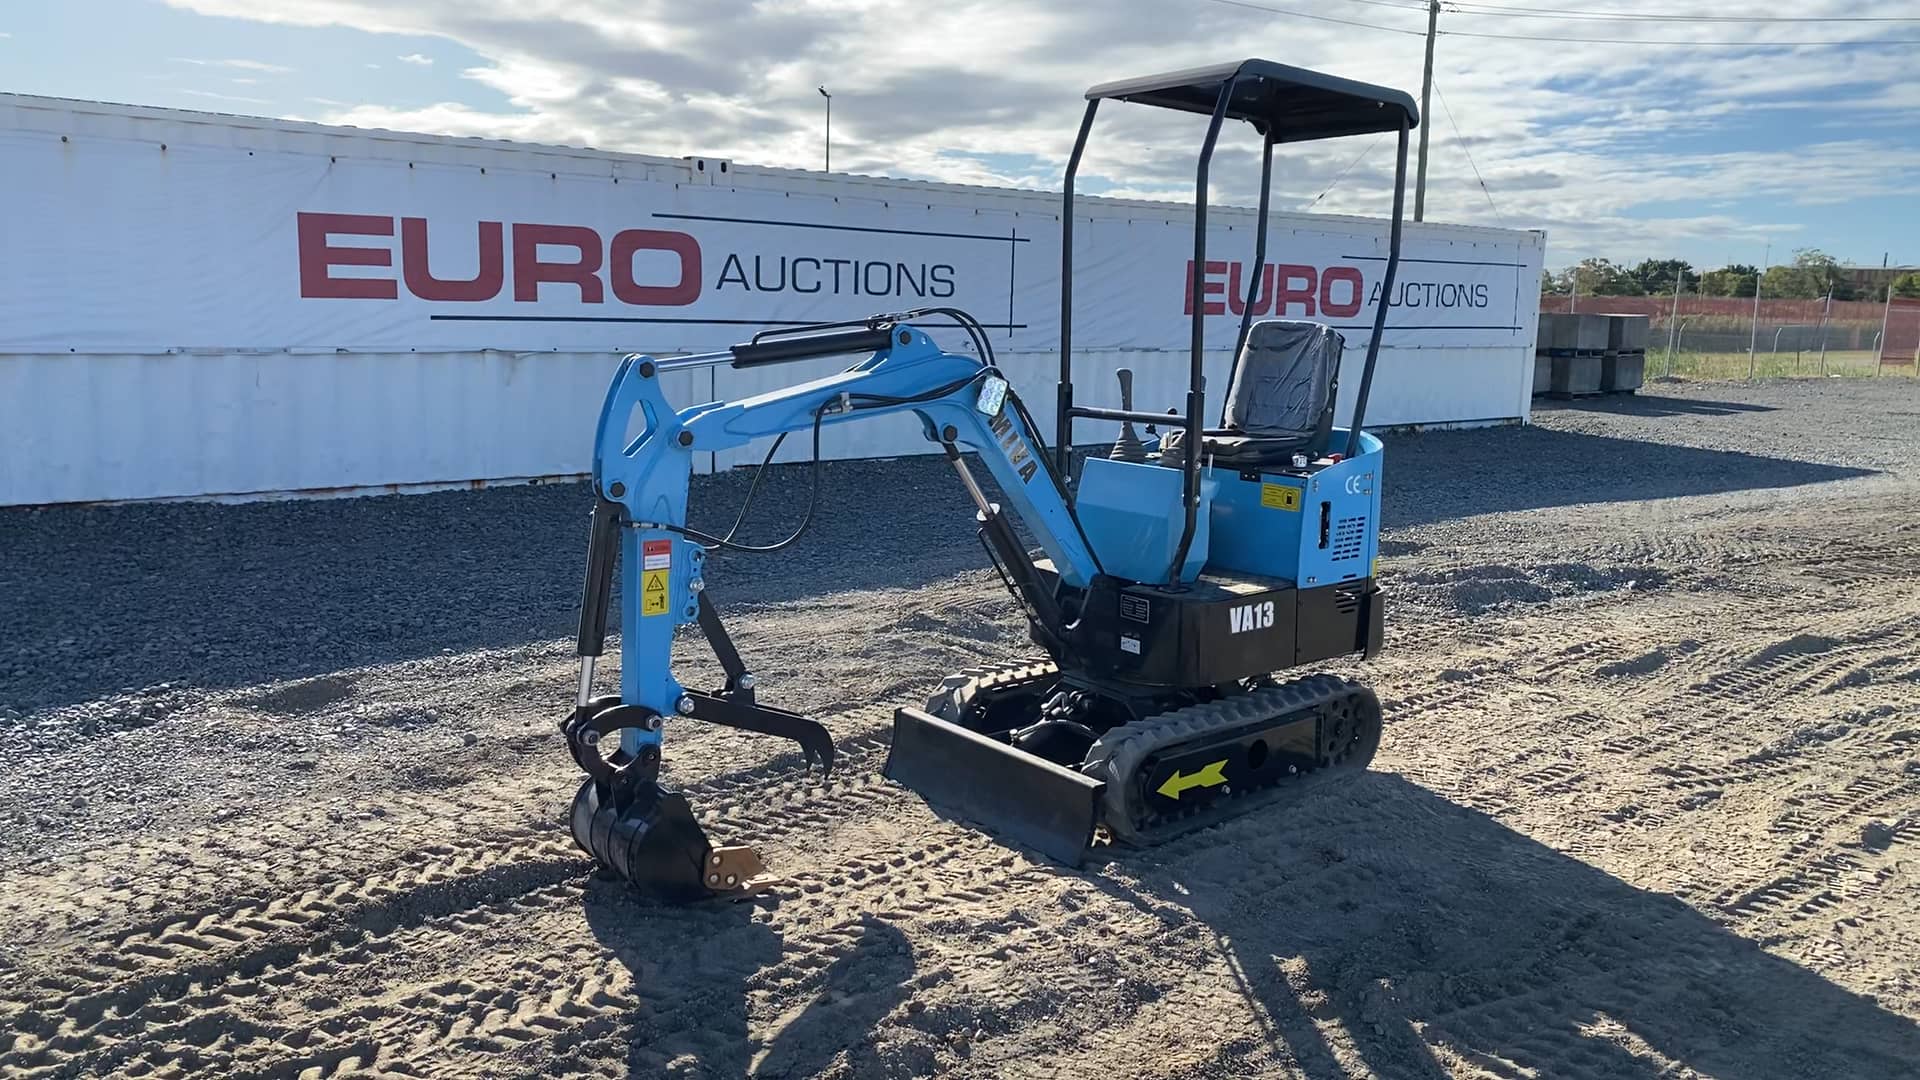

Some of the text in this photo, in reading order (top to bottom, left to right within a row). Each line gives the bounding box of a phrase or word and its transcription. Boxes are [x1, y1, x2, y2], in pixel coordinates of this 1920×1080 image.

[297, 211, 955, 306] EURO AUCTIONS
[1184, 260, 1488, 318] EURO AUCTIONS
[1345, 474, 1361, 495] CE
[1229, 601, 1275, 634] VA13
